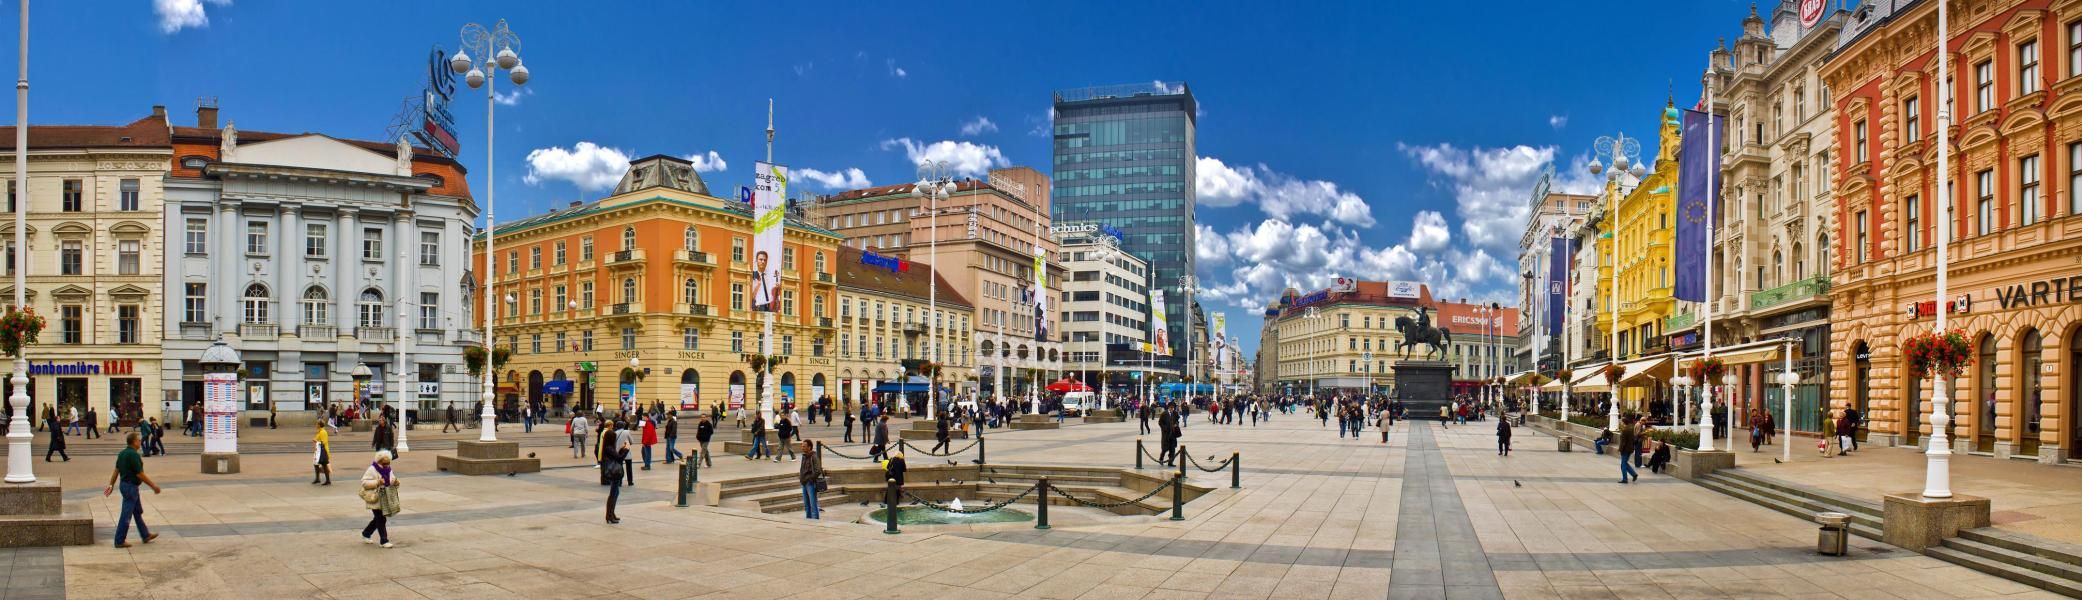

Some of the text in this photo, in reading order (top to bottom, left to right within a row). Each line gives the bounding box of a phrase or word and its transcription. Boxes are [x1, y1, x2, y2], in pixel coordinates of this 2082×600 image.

[755, 173, 785, 183] zagreb
[614, 351, 640, 359] SINGER
[678, 351, 705, 359] SINGER
[809, 357, 829, 365] SINGER
[29, 360, 99, 375] bonbonnière
